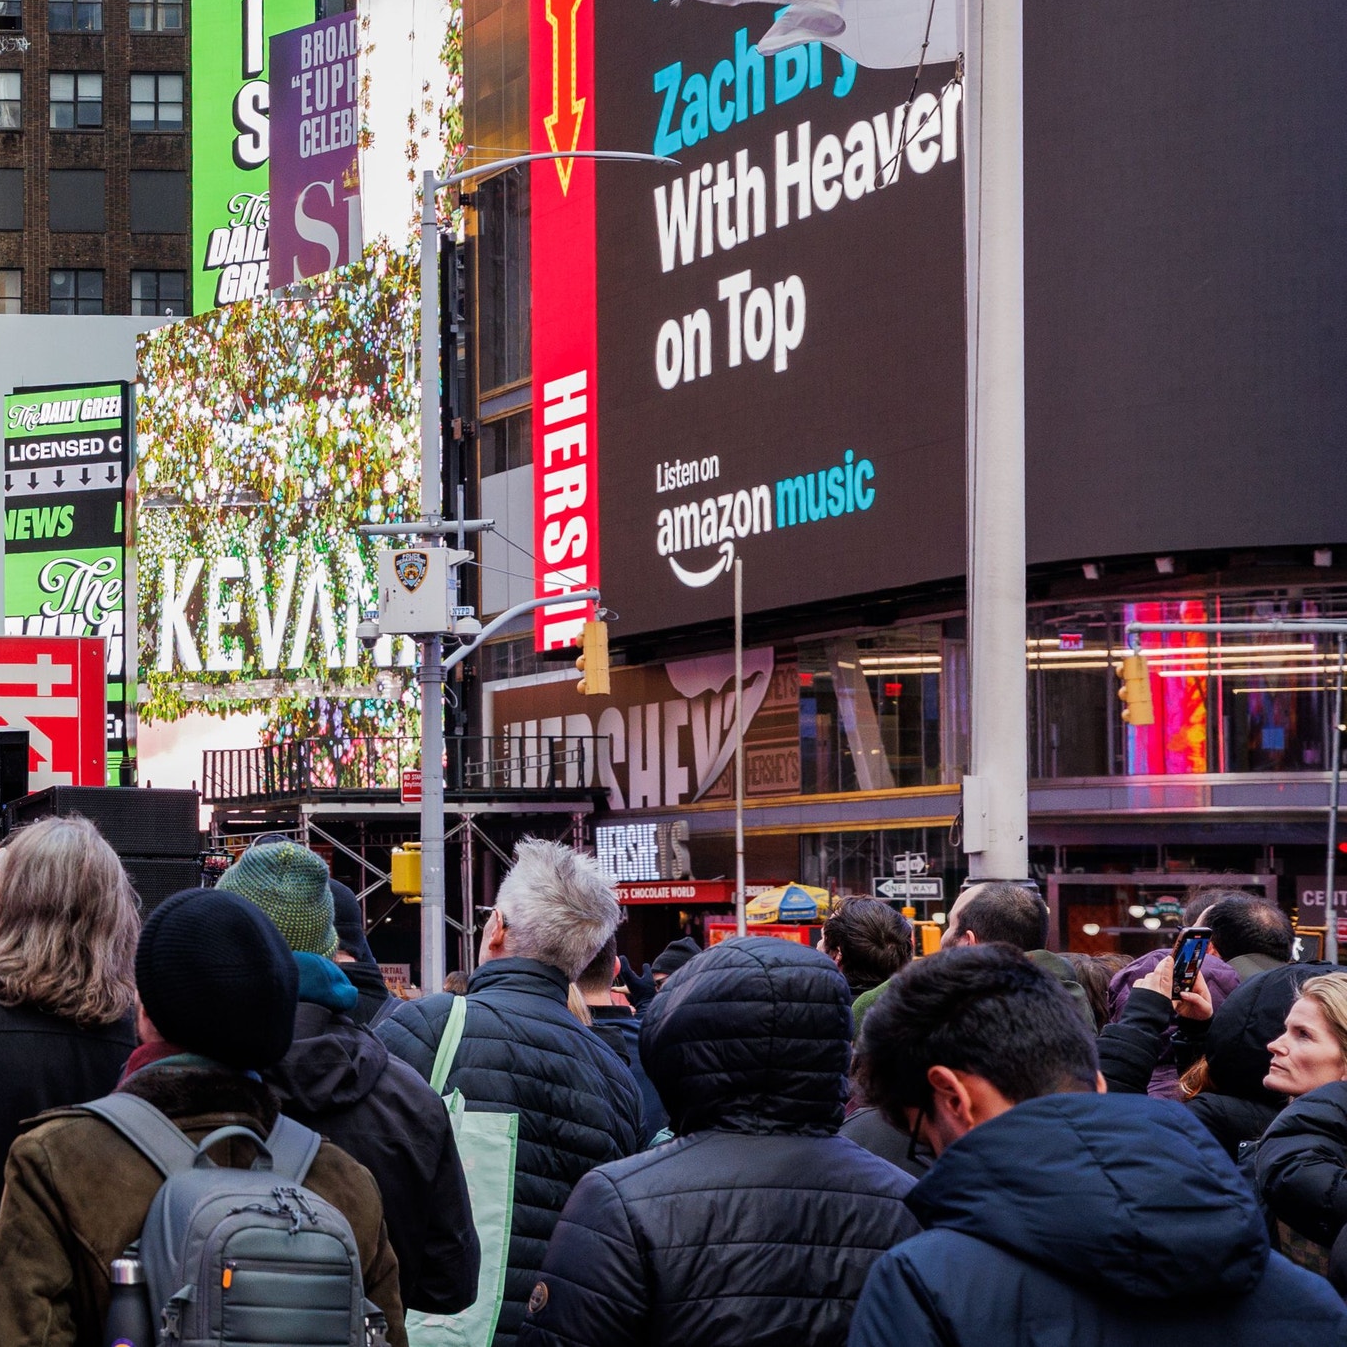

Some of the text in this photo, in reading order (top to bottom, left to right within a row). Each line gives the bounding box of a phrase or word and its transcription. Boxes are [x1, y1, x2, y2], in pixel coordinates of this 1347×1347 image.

[653, 27, 766, 157] Zach
[299, 105, 357, 159] CELEB
[653, 148, 767, 273] With
[655, 268, 807, 391] on Top
[39, 399, 82, 425] DAILY
[9, 438, 104, 462] LICENSED
[656, 452, 721, 494] Listen on
[656, 448, 877, 557] amazon music
[38, 556, 124, 625] The
[158, 553, 417, 671] KEVAN
[363, 610, 380, 619] NYP
[452, 607, 470, 615] NYPD
[630, 887, 671, 899] CHOCOLATE
[670, 886, 696, 898] WORLD
[884, 884, 903, 893] ONE
